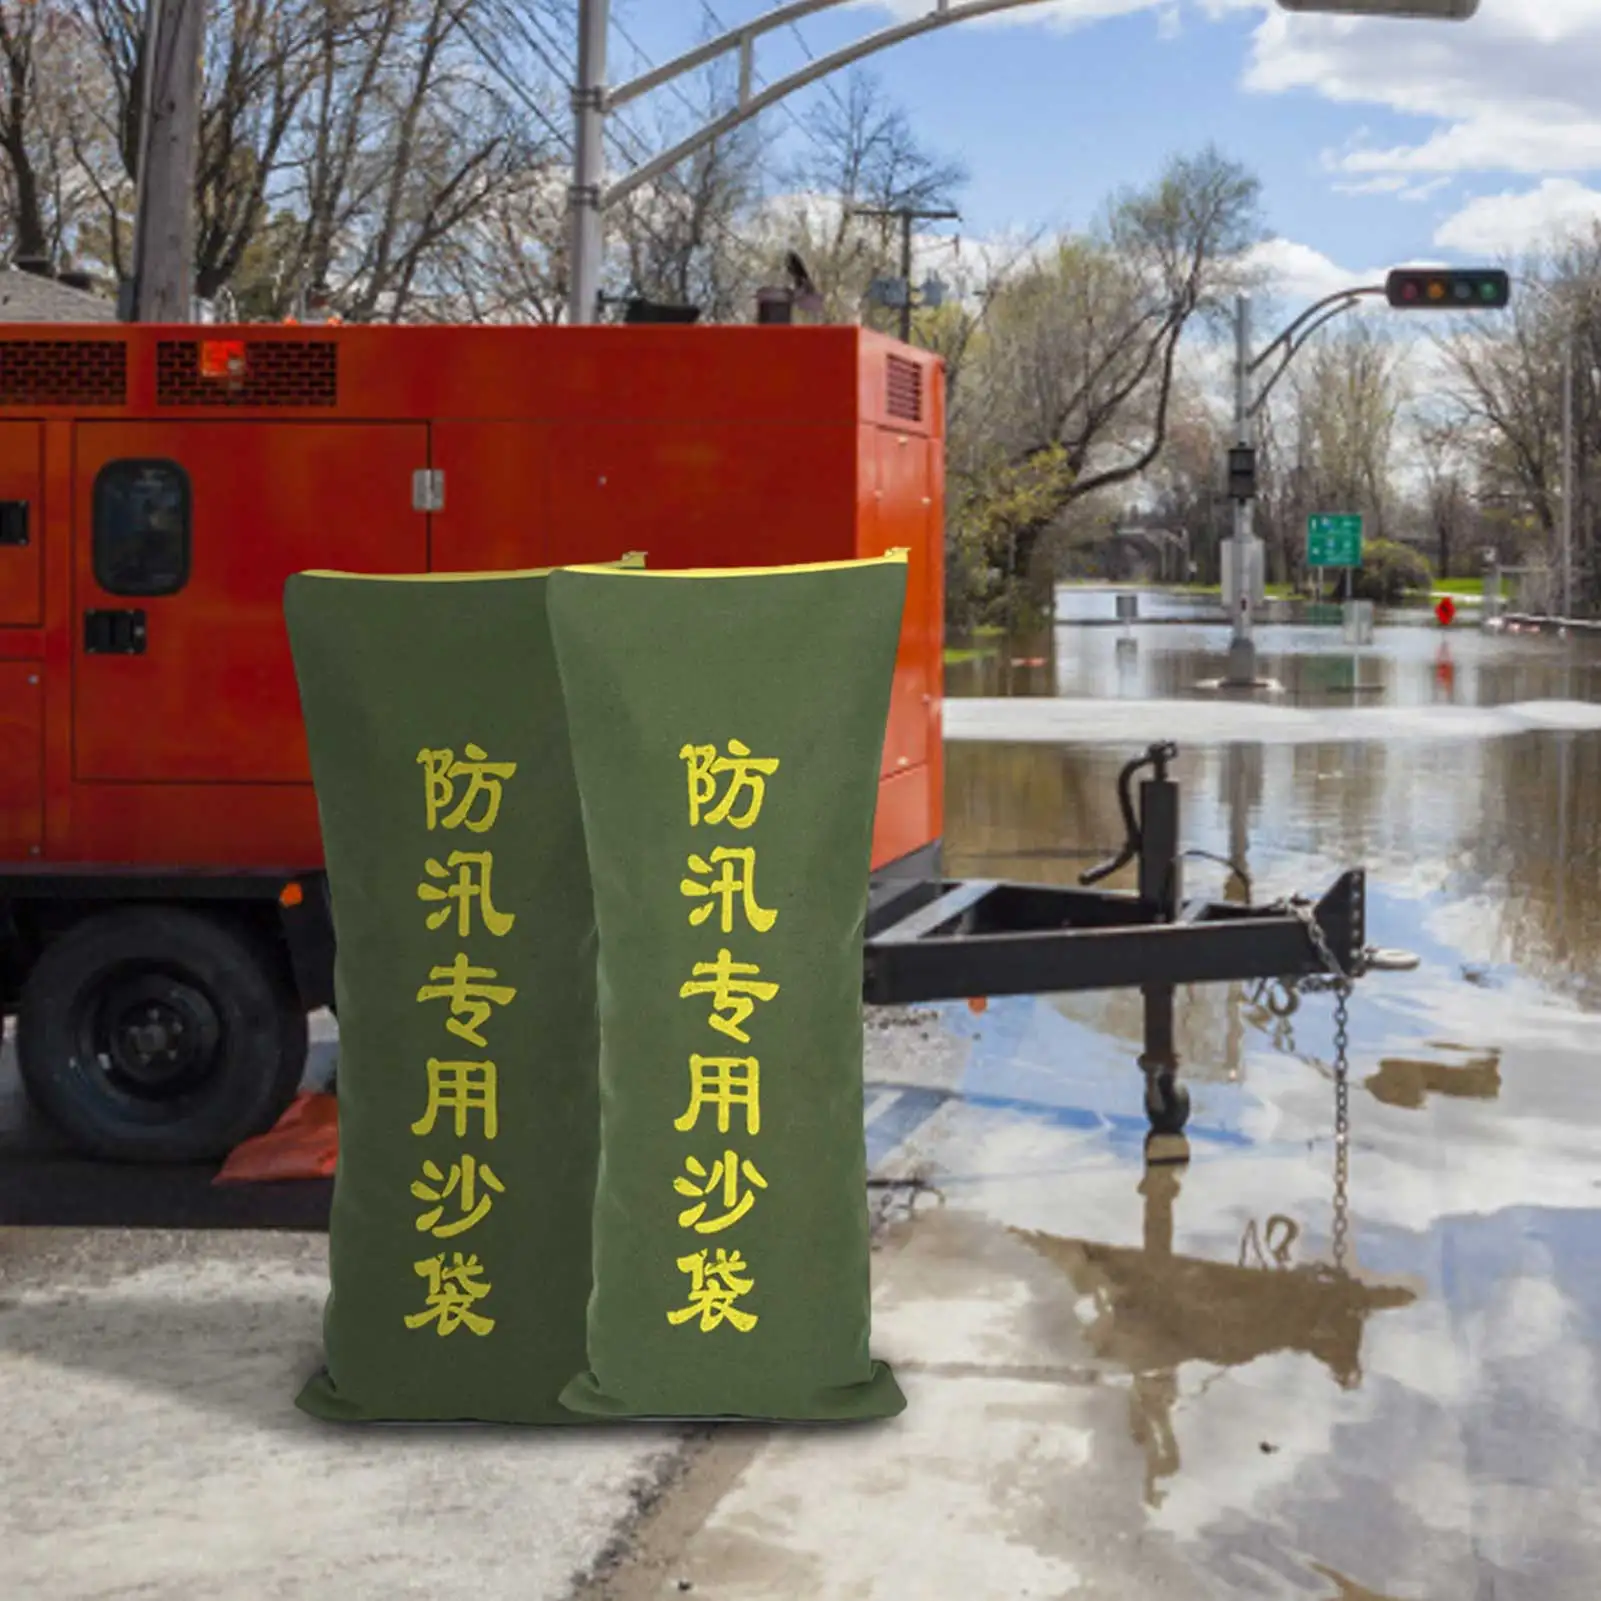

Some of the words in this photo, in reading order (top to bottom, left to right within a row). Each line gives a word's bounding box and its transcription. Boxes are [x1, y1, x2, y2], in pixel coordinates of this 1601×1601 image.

[404, 742, 517, 1336] 防汛专用沙袋
[667, 739, 779, 1333] 防汛专用沙袋
